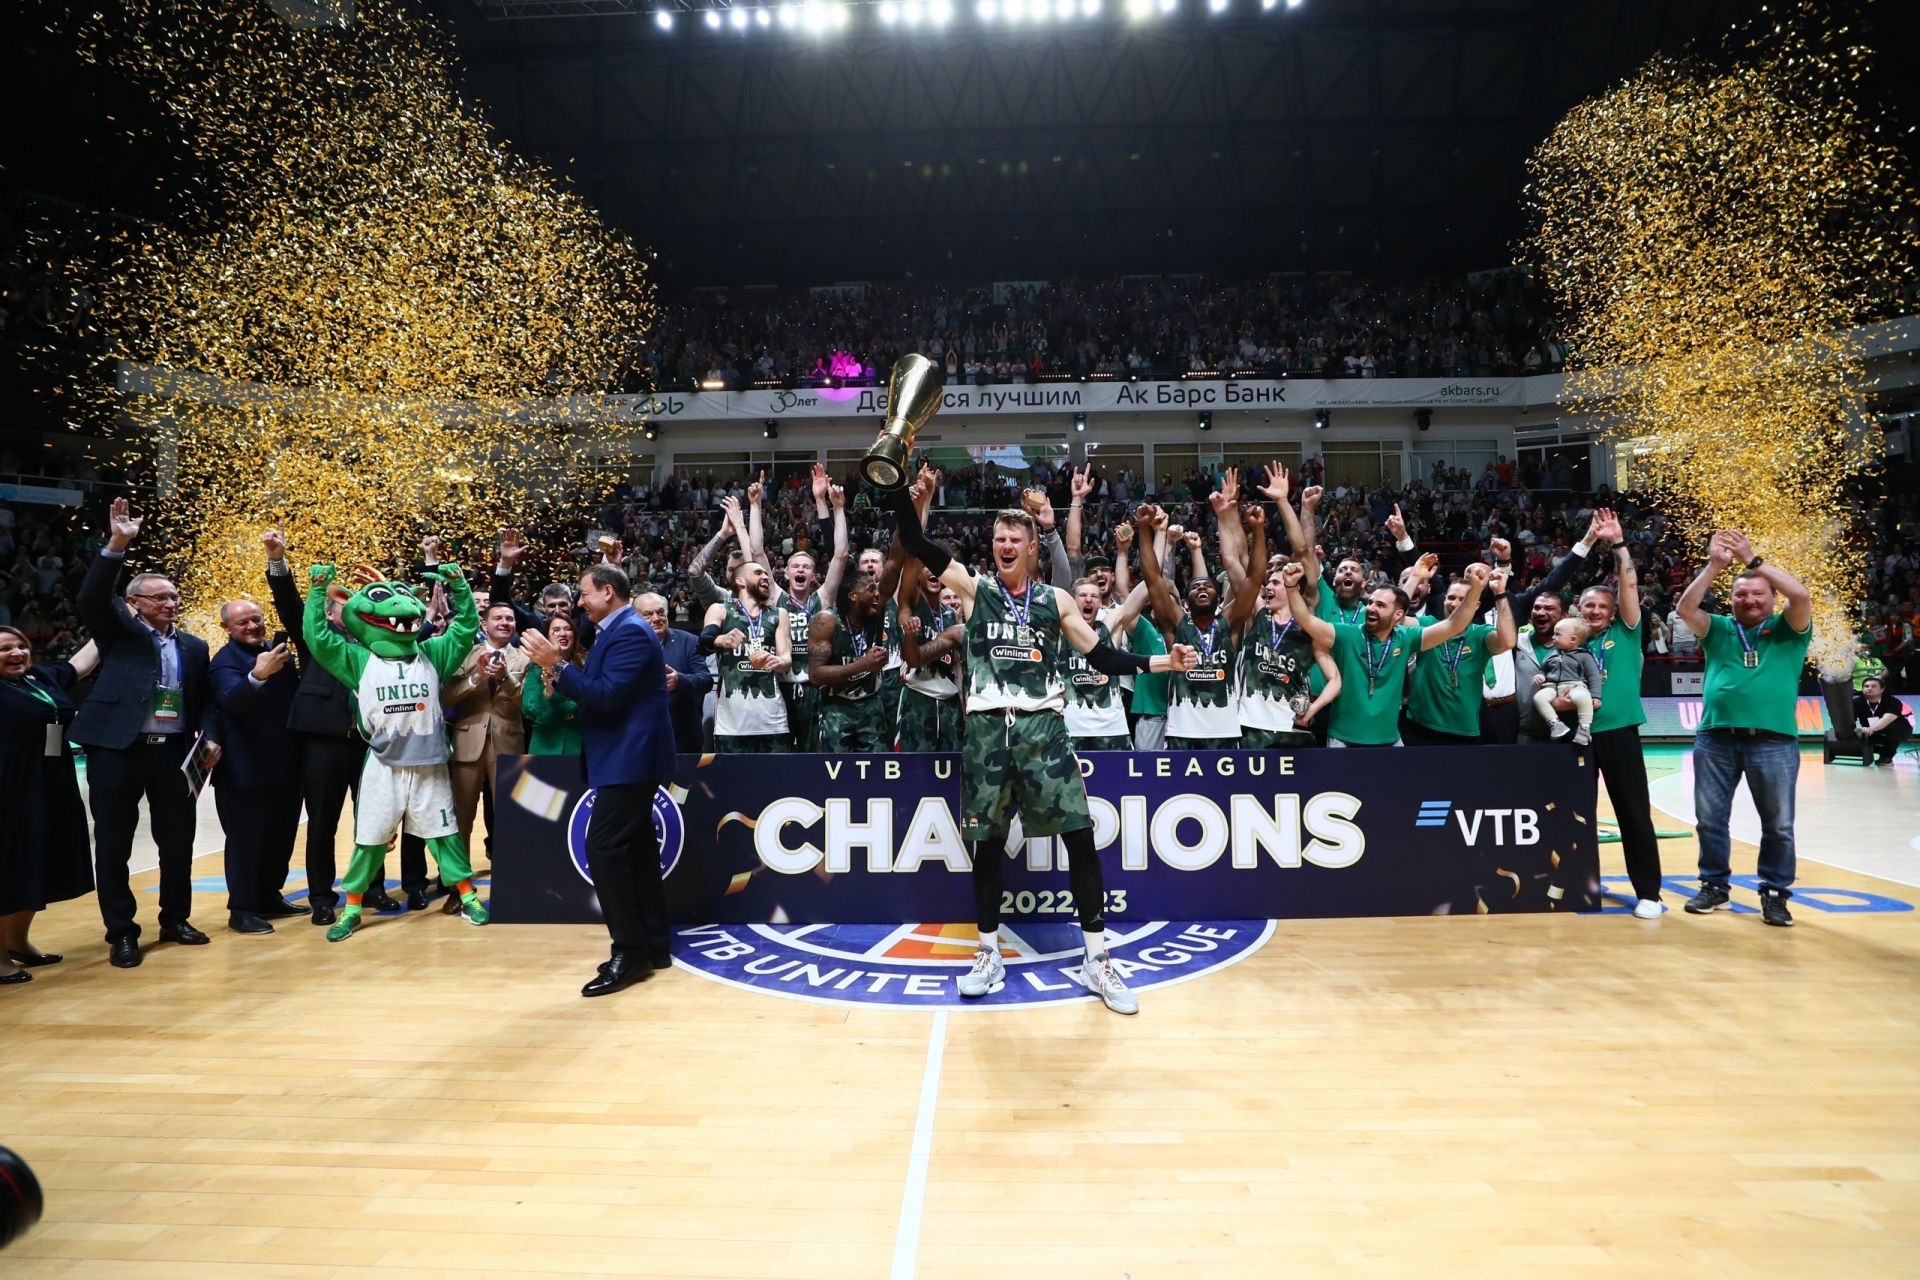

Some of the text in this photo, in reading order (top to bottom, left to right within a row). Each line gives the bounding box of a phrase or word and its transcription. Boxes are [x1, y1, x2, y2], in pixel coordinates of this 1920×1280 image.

[856, 389, 1082, 413] Деся лучшим
[1116, 382, 1286, 408] Ак Барс Банк
[1440, 385, 1500, 397] akbars.ru
[797, 398, 818, 407] лет
[995, 648, 1030, 658] Winline
[1254, 641, 1296, 672] UNCS
[397, 662, 405, 680] 1
[376, 683, 430, 702] UNICS
[384, 703, 414, 713] Winline
[824, 759, 902, 780] VTB
[1128, 756, 1295, 777] LEAGUE
[440, 808, 449, 827] 1
[1455, 808, 1540, 846] VTB
[676, 923, 756, 961] VTB
